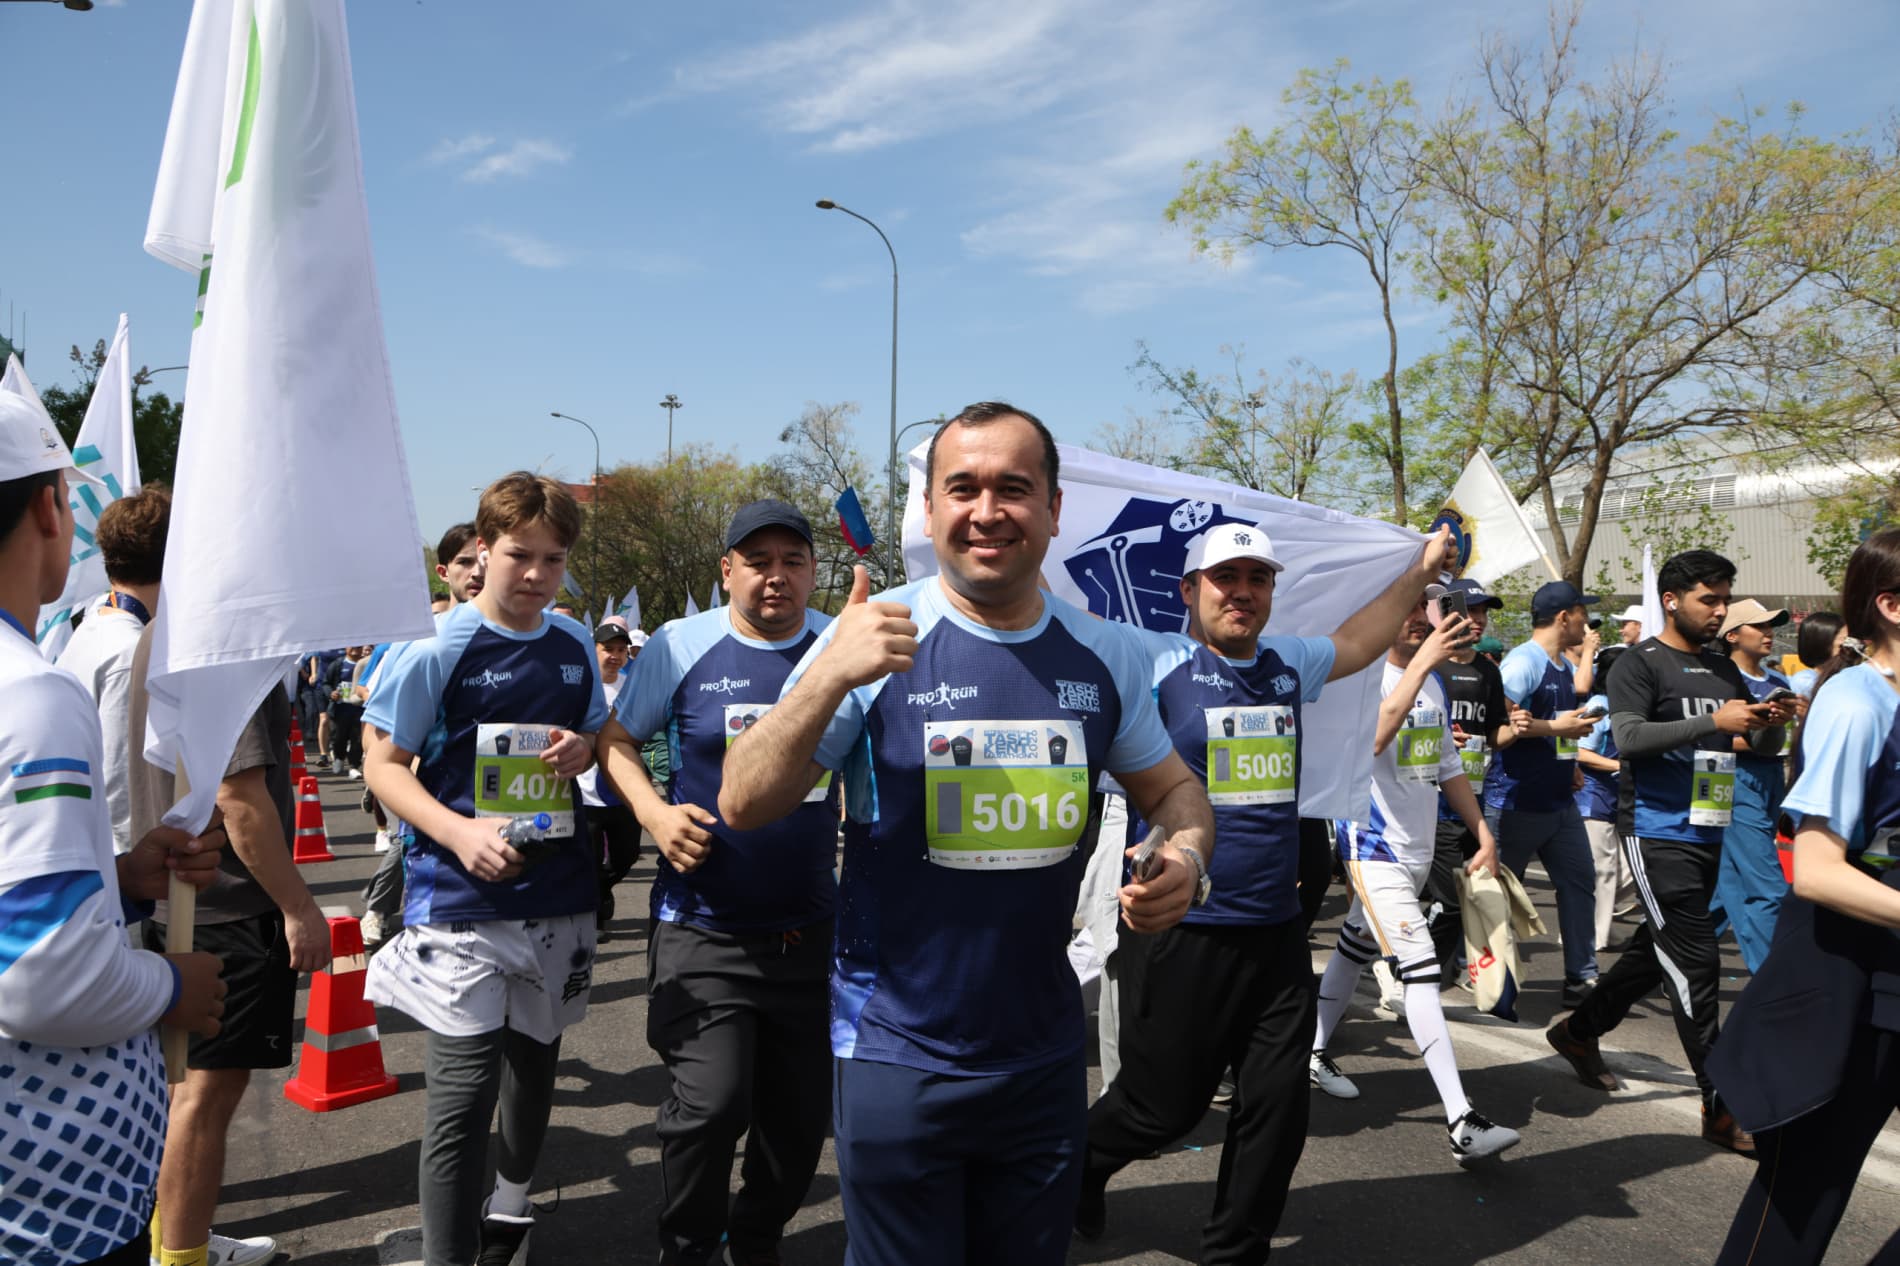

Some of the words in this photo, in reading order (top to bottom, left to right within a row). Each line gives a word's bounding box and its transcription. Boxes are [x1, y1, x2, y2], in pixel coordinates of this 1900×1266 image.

[462, 678, 482, 687] PRO
[493, 671, 512, 681] RUN
[700, 682, 719, 691] PRO
[731, 679, 750, 688] RUN
[1192, 674, 1211, 683] PRO
[1219, 678, 1233, 688] RUN
[907, 691, 935, 705] PRO
[951, 686, 978, 700] RUN
[1056, 682, 1092, 698] TASH
[1058, 693, 1093, 708] KENT
[984, 731, 1030, 745] TASH
[984, 744, 1027, 755] KENT
[1237, 752, 1293, 780] 5003
[487, 774, 497, 792] E
[1072, 772, 1086, 783] 5K
[1702, 784, 1709, 797] E
[1713, 784, 1734, 802] 59
[972, 791, 1080, 832] 5016
